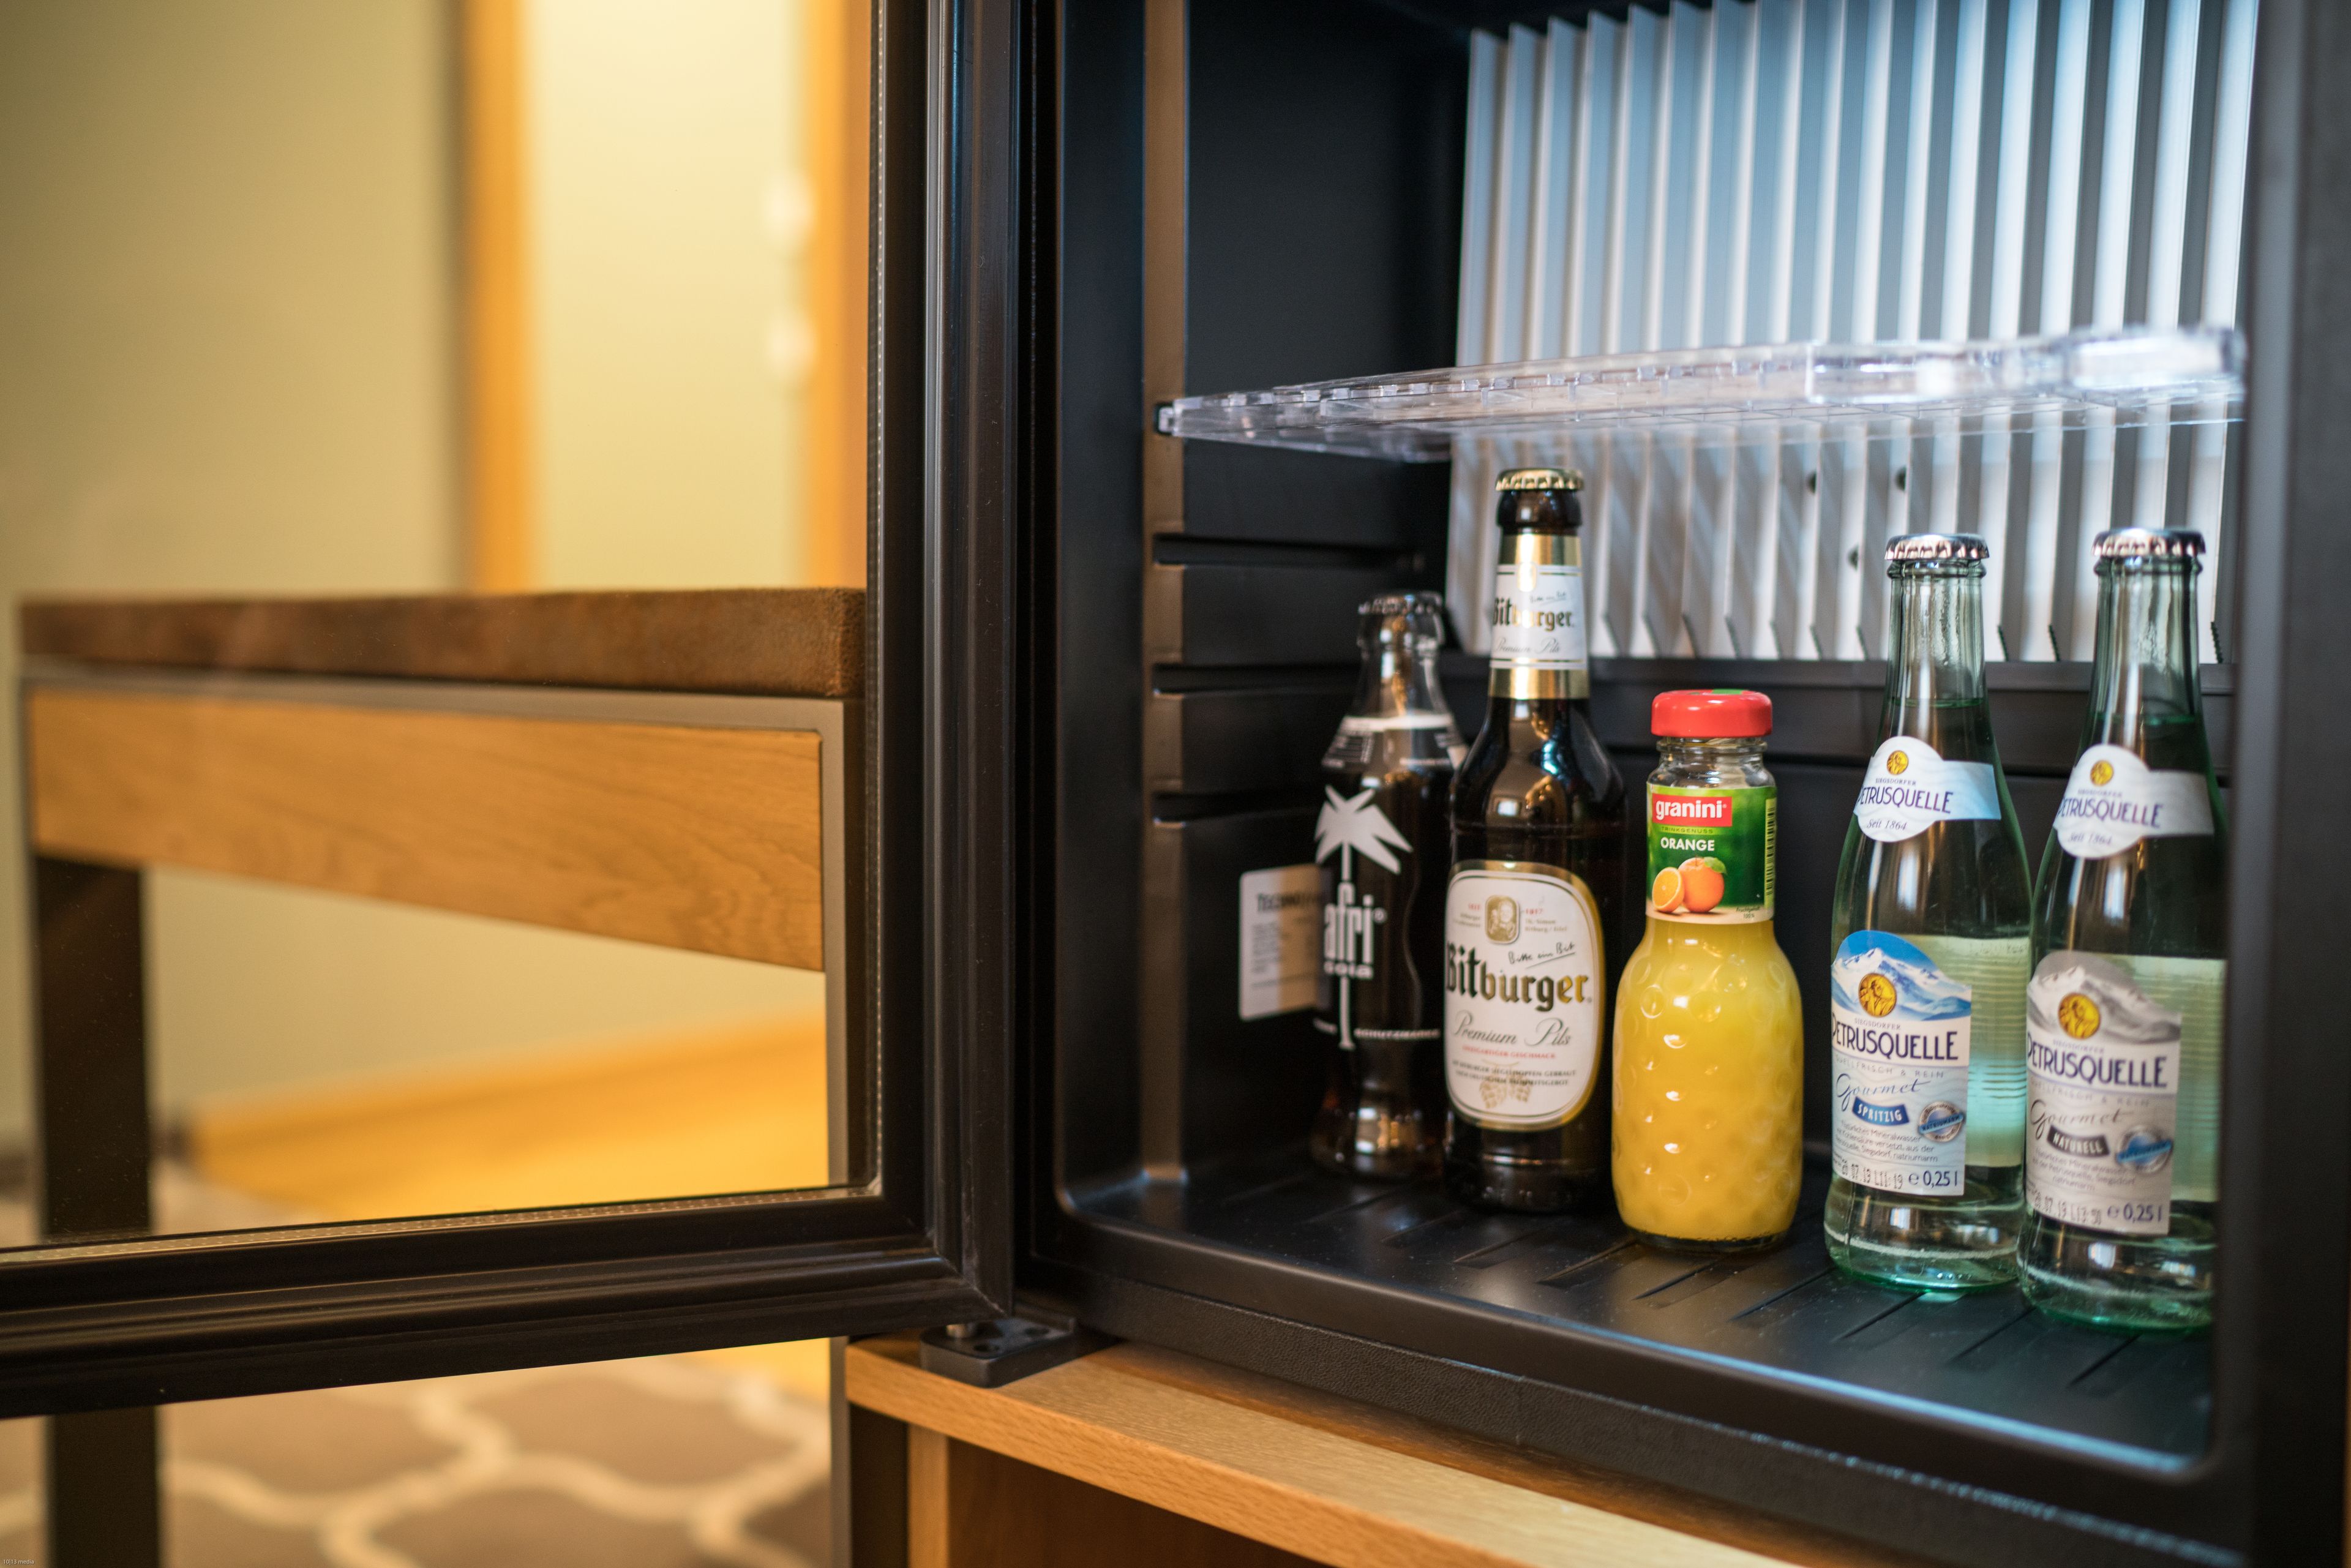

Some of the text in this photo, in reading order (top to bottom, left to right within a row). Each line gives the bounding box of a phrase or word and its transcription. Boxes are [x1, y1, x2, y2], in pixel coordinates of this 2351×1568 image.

[1535, 637, 1561, 654] Pils
[1655, 800, 1722, 820] granini
[1866, 819, 1907, 831] Seit 1864
[1660, 837, 1714, 852] ORANGE
[1324, 882, 1373, 964] afri
[1509, 951, 1532, 964] Bitte
[1556, 942, 1575, 955] Bit
[1446, 941, 1589, 1012] Bitburger
[1453, 1010, 1572, 1046] Premium Pils
[1854, 1017, 1901, 1030] SIEGSDORFER
[1836, 1073, 1931, 1112] Gourmet
[1857, 1103, 1903, 1123] SPRITZIG
[2030, 1099, 2134, 1140] Gourmet
[2053, 1132, 2103, 1154] NATURELL
[1923, 1170, 1951, 1188] 0,25
[2123, 1203, 2153, 1223] 0,25
